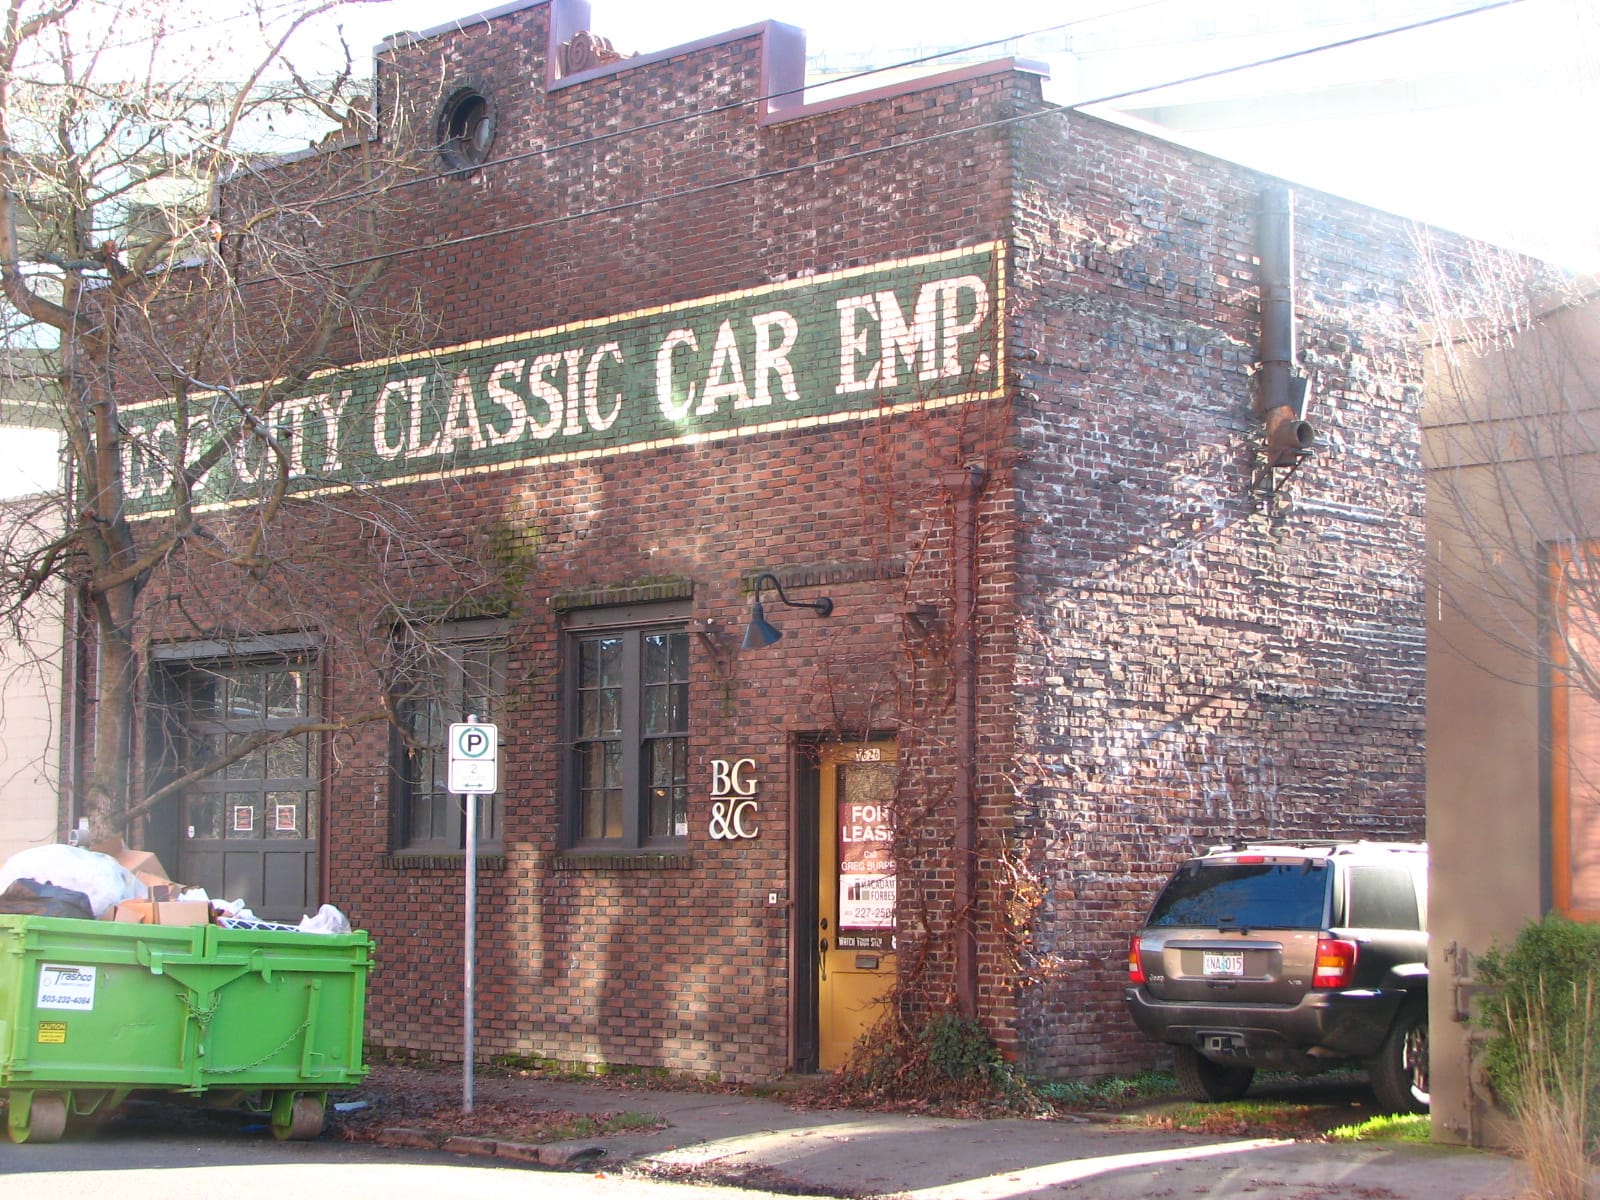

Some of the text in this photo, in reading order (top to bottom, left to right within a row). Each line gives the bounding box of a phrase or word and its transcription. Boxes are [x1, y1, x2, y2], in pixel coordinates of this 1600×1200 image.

[373, 341, 625, 461] CLASSIC
[655, 310, 801, 421] CAR
[836, 274, 990, 395] EMP.
[467, 734, 482, 752] P
[470, 763, 478, 774] 2
[710, 758, 758, 796] BG
[708, 799, 759, 840] &C
[851, 805, 889, 823] FOR
[841, 861, 865, 871] GREG
[871, 890, 896, 901] FORBES
[44, 967, 93, 985] Trashco
[1149, 973, 1165, 982] Jeep
